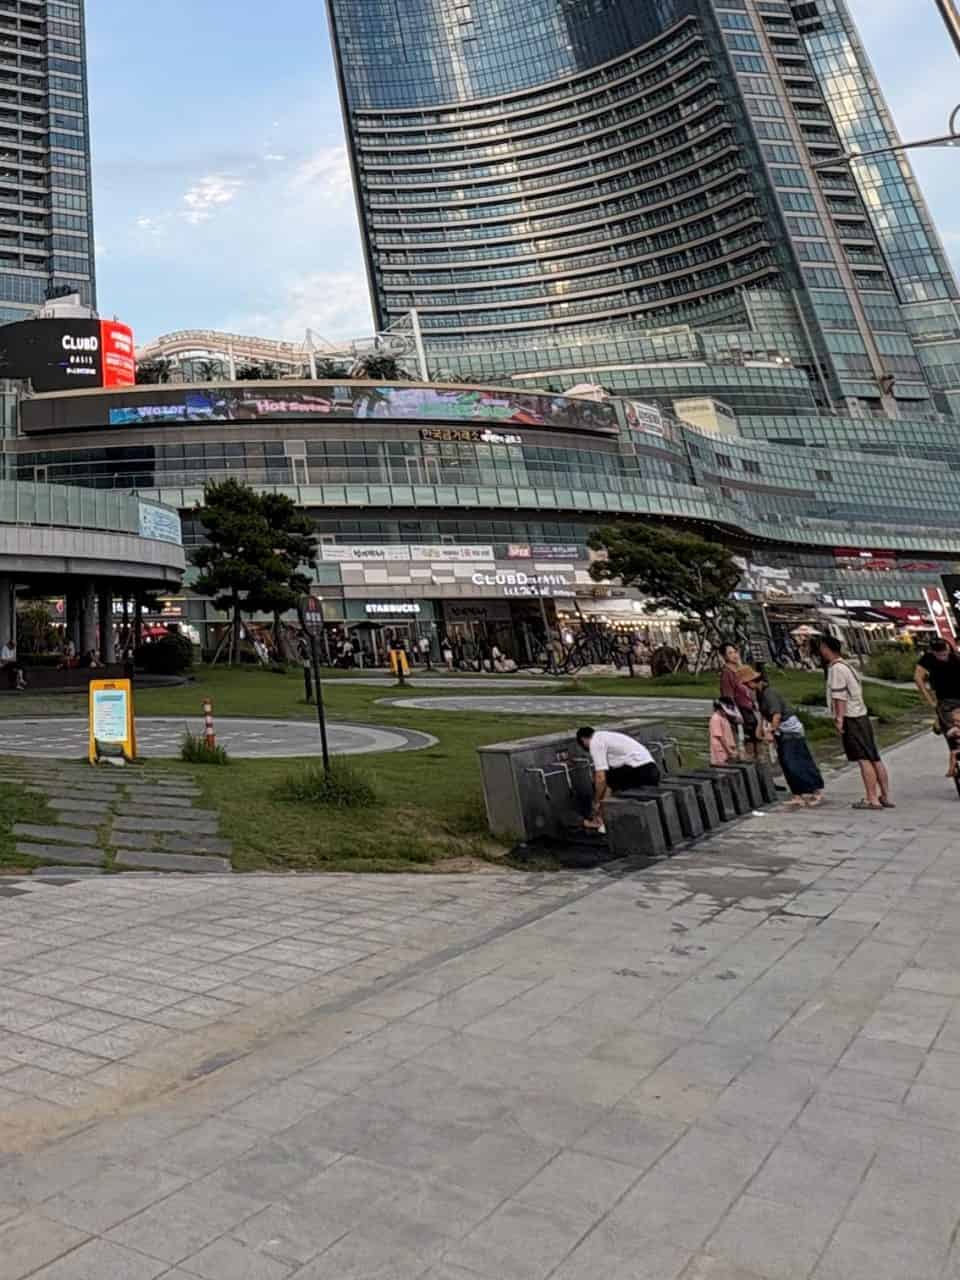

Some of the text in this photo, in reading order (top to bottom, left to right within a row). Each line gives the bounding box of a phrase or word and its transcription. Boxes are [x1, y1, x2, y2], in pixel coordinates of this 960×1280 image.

[62, 335, 98, 351] CLUBD
[472, 572, 527, 585] CLUBD
[365, 603, 420, 613] STARBUCKS
